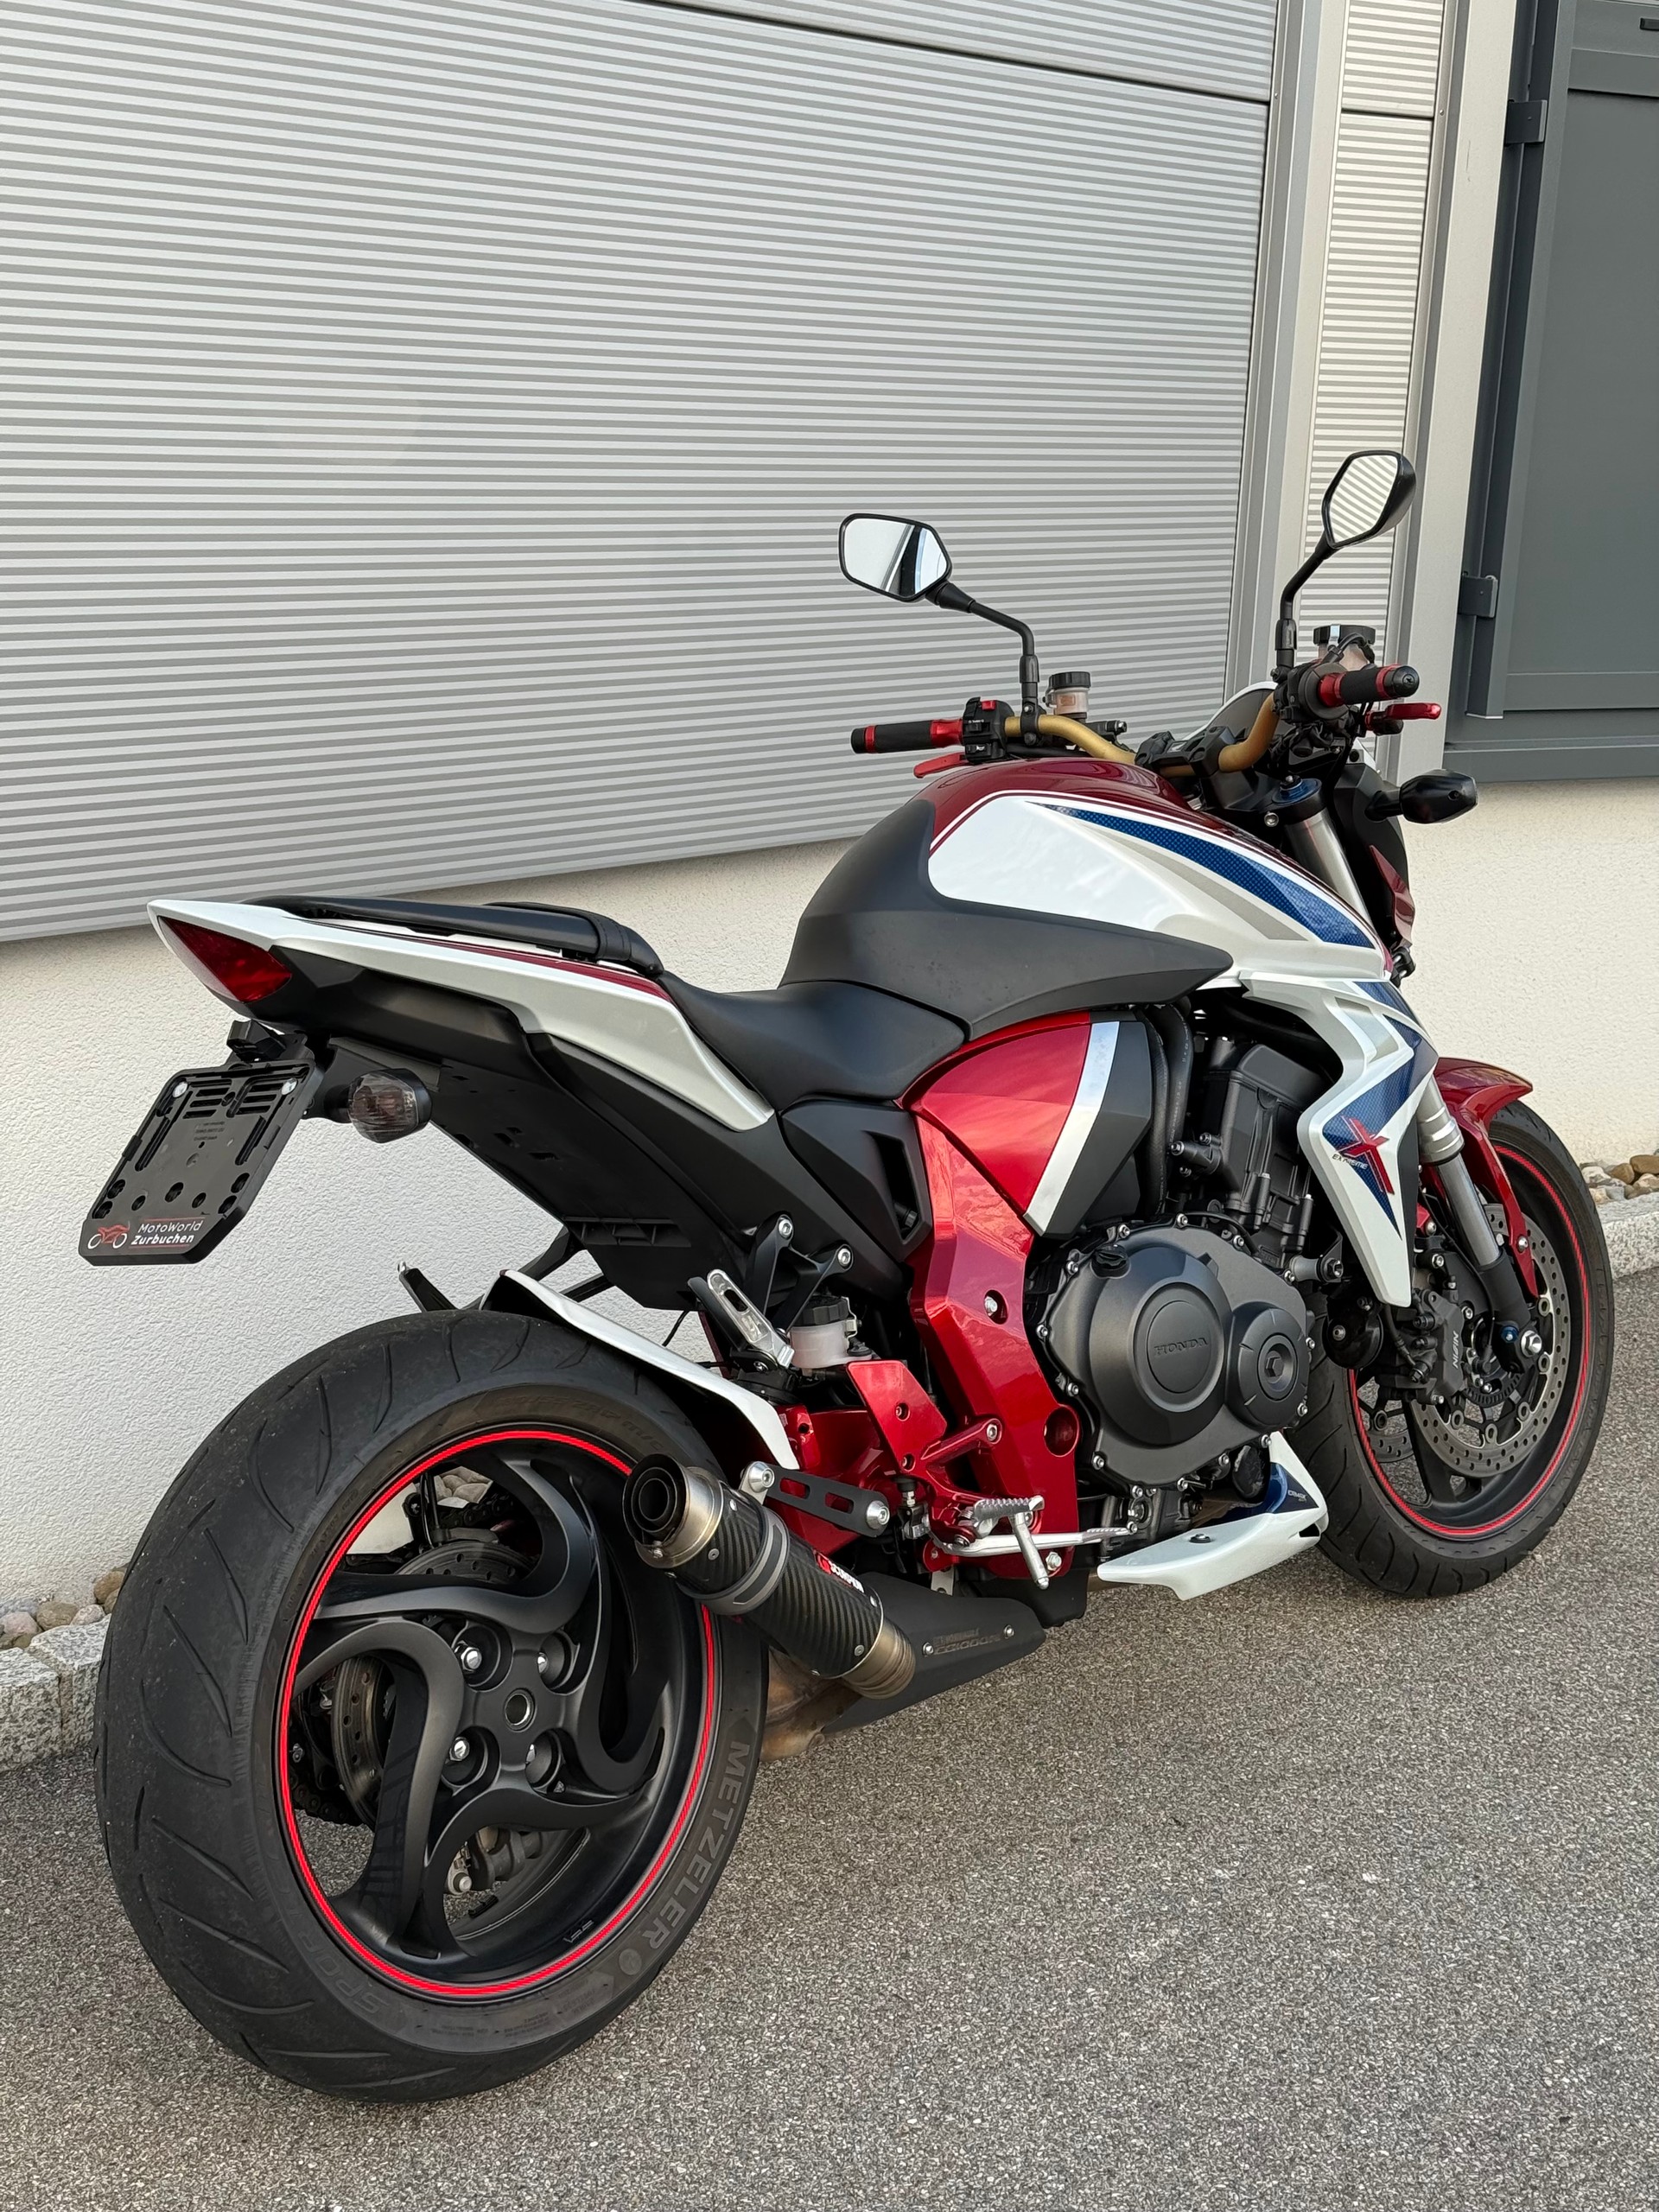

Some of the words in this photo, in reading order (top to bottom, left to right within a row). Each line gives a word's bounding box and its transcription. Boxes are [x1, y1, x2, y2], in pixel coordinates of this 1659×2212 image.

[137, 1220, 204, 1233] MotoWorld
[130, 1234, 194, 1245] Zurbuchen
[1154, 1337, 1209, 1356] HONDA
[641, 1740, 751, 1949] METZELER
